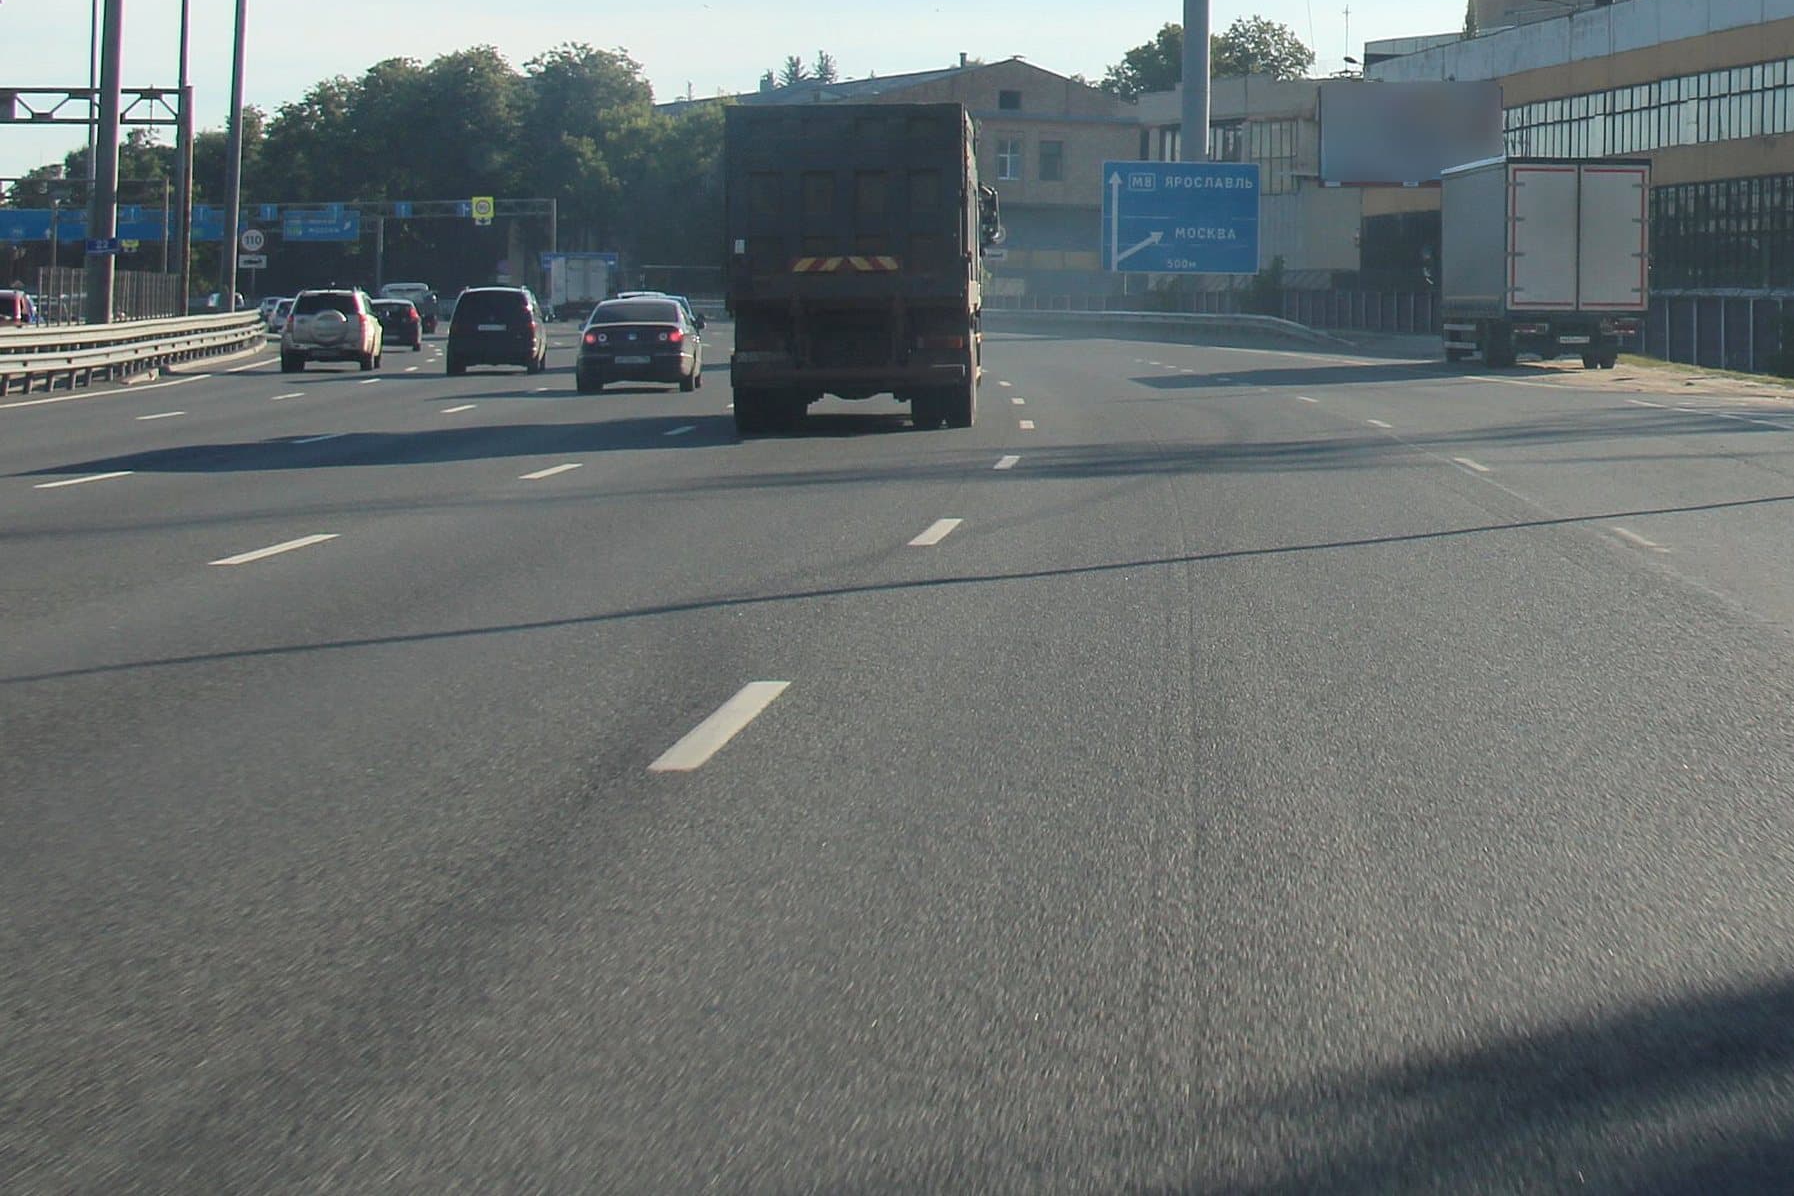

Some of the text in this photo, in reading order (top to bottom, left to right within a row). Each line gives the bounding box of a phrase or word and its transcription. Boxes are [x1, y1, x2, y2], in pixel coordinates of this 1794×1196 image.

[1131, 176, 1253, 189] М8 ЯРОСЛАВЛЬ
[245, 235, 262, 245] 110
[1175, 227, 1237, 240] МОСКВА
